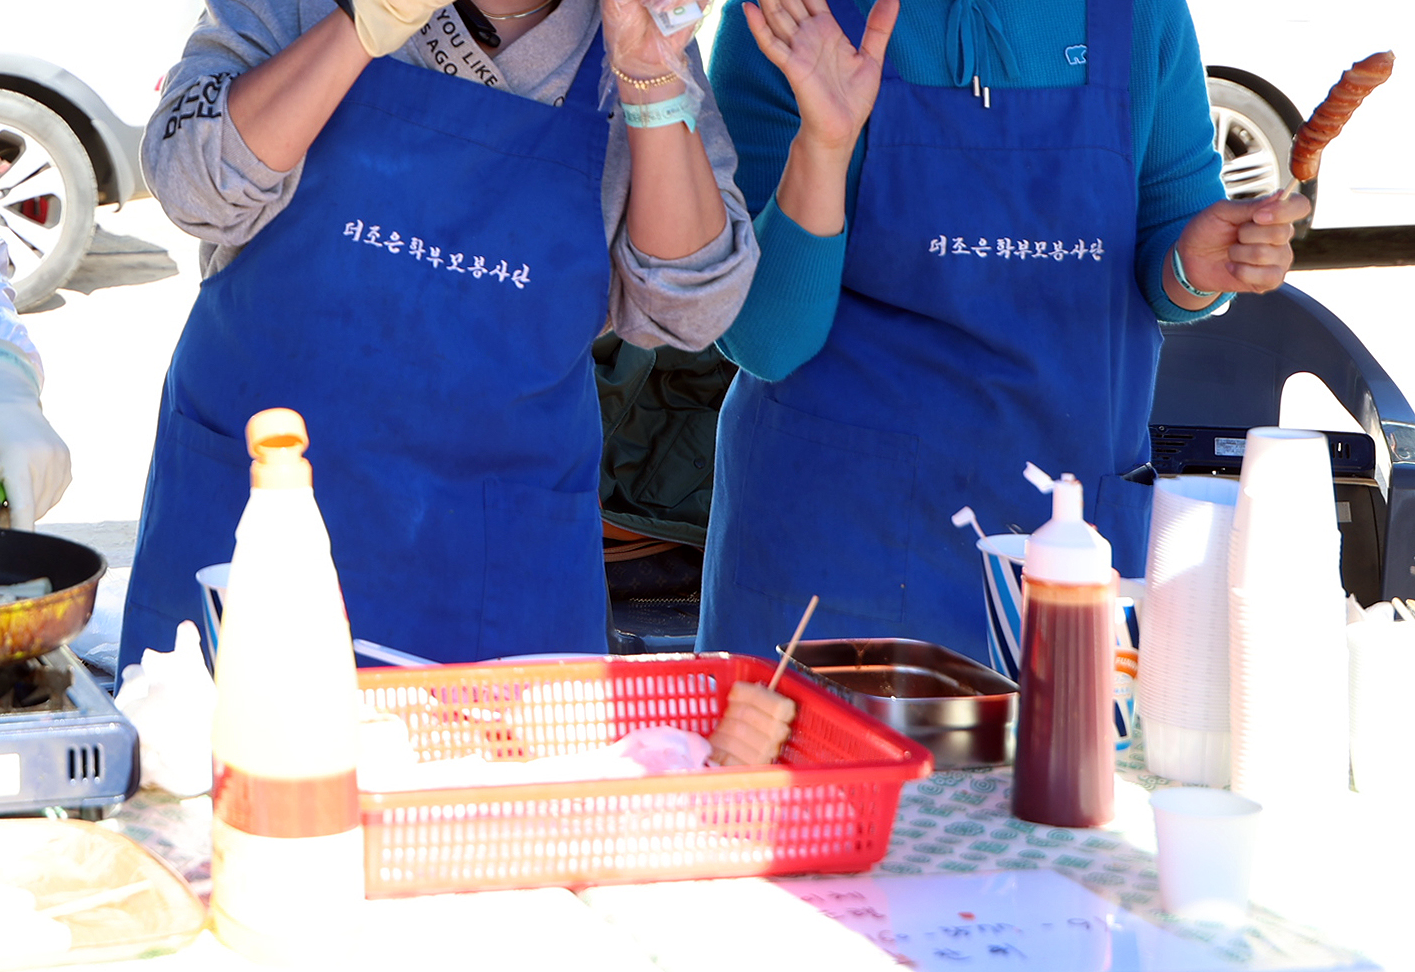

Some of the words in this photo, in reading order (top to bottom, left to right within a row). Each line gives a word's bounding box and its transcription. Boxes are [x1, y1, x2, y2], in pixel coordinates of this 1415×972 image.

[426, 38, 458, 76] AGO
[436, 9, 465, 48] YOU
[462, 51, 499, 87] LIKE
